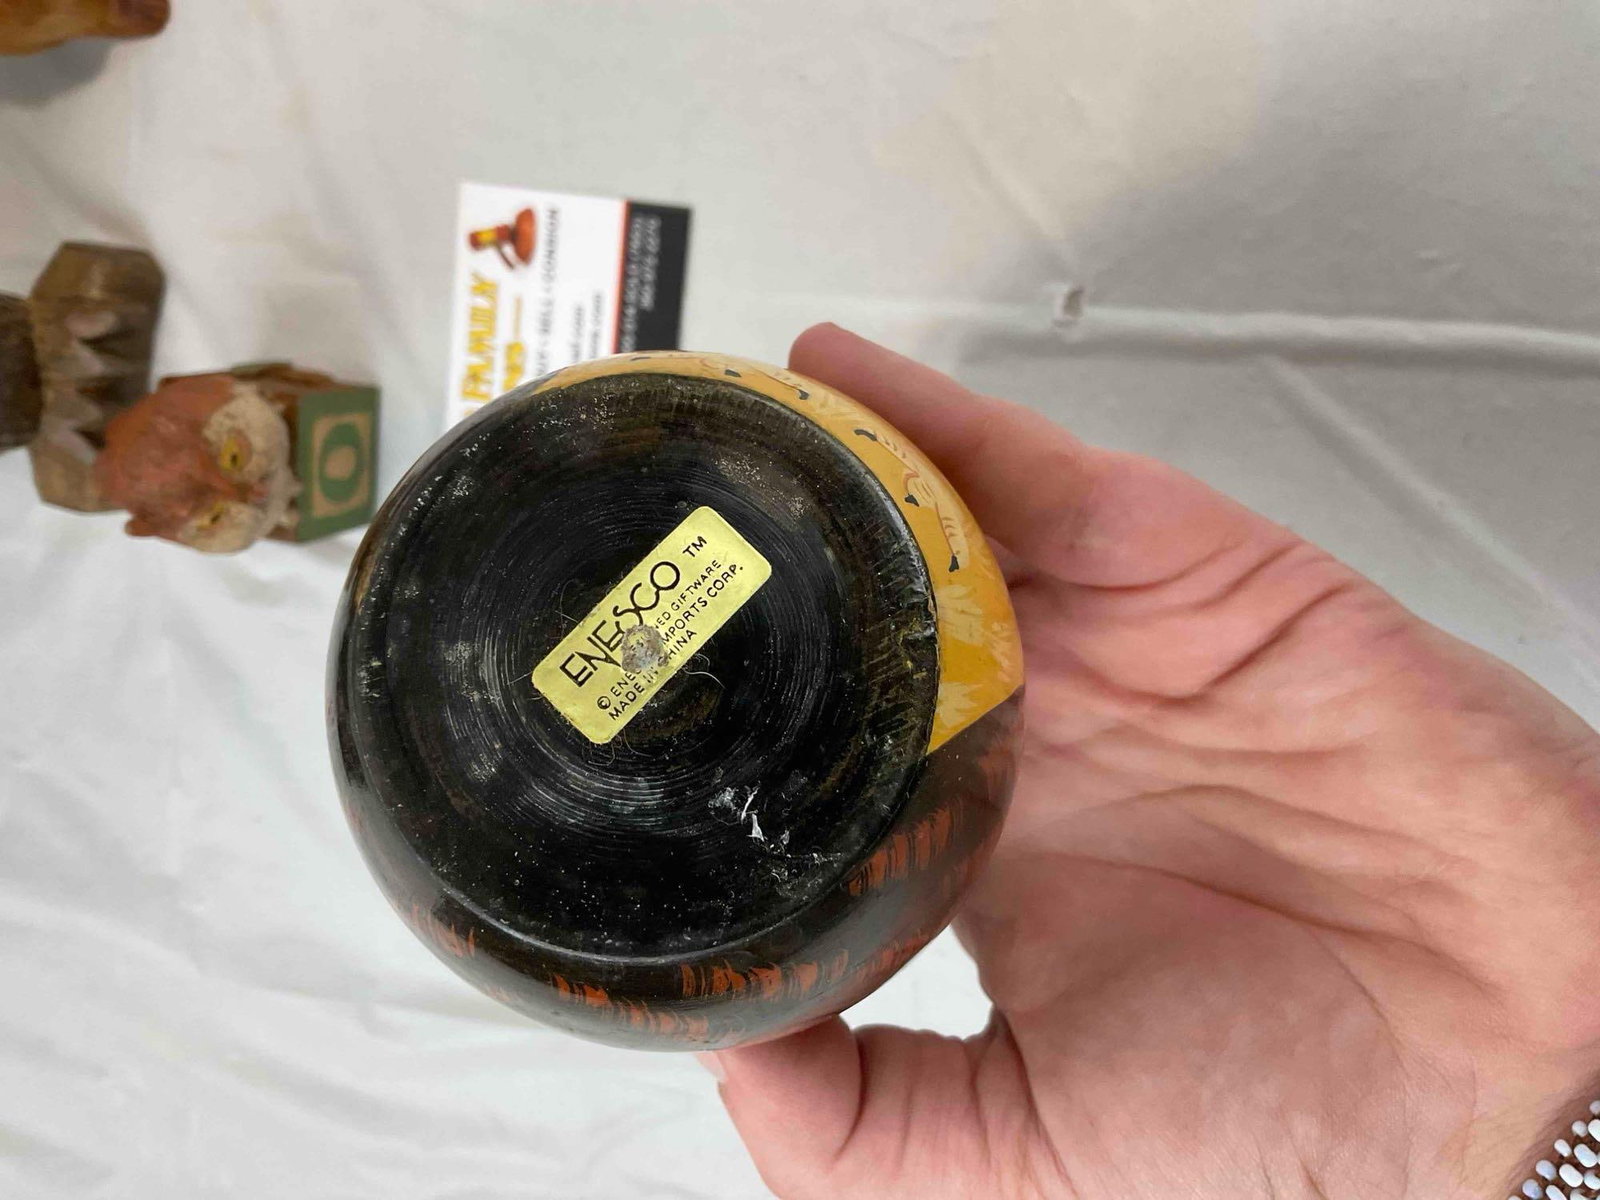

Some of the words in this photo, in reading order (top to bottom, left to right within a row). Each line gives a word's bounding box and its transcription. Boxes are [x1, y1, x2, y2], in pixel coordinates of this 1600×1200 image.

[559, 561, 681, 688] ENESCO
[682, 535, 708, 558] TM
[660, 597, 708, 645] MPORTS
[706, 563, 744, 598] CORP.
[671, 559, 722, 611] GIFTWARE
[608, 682, 645, 721] MADE
